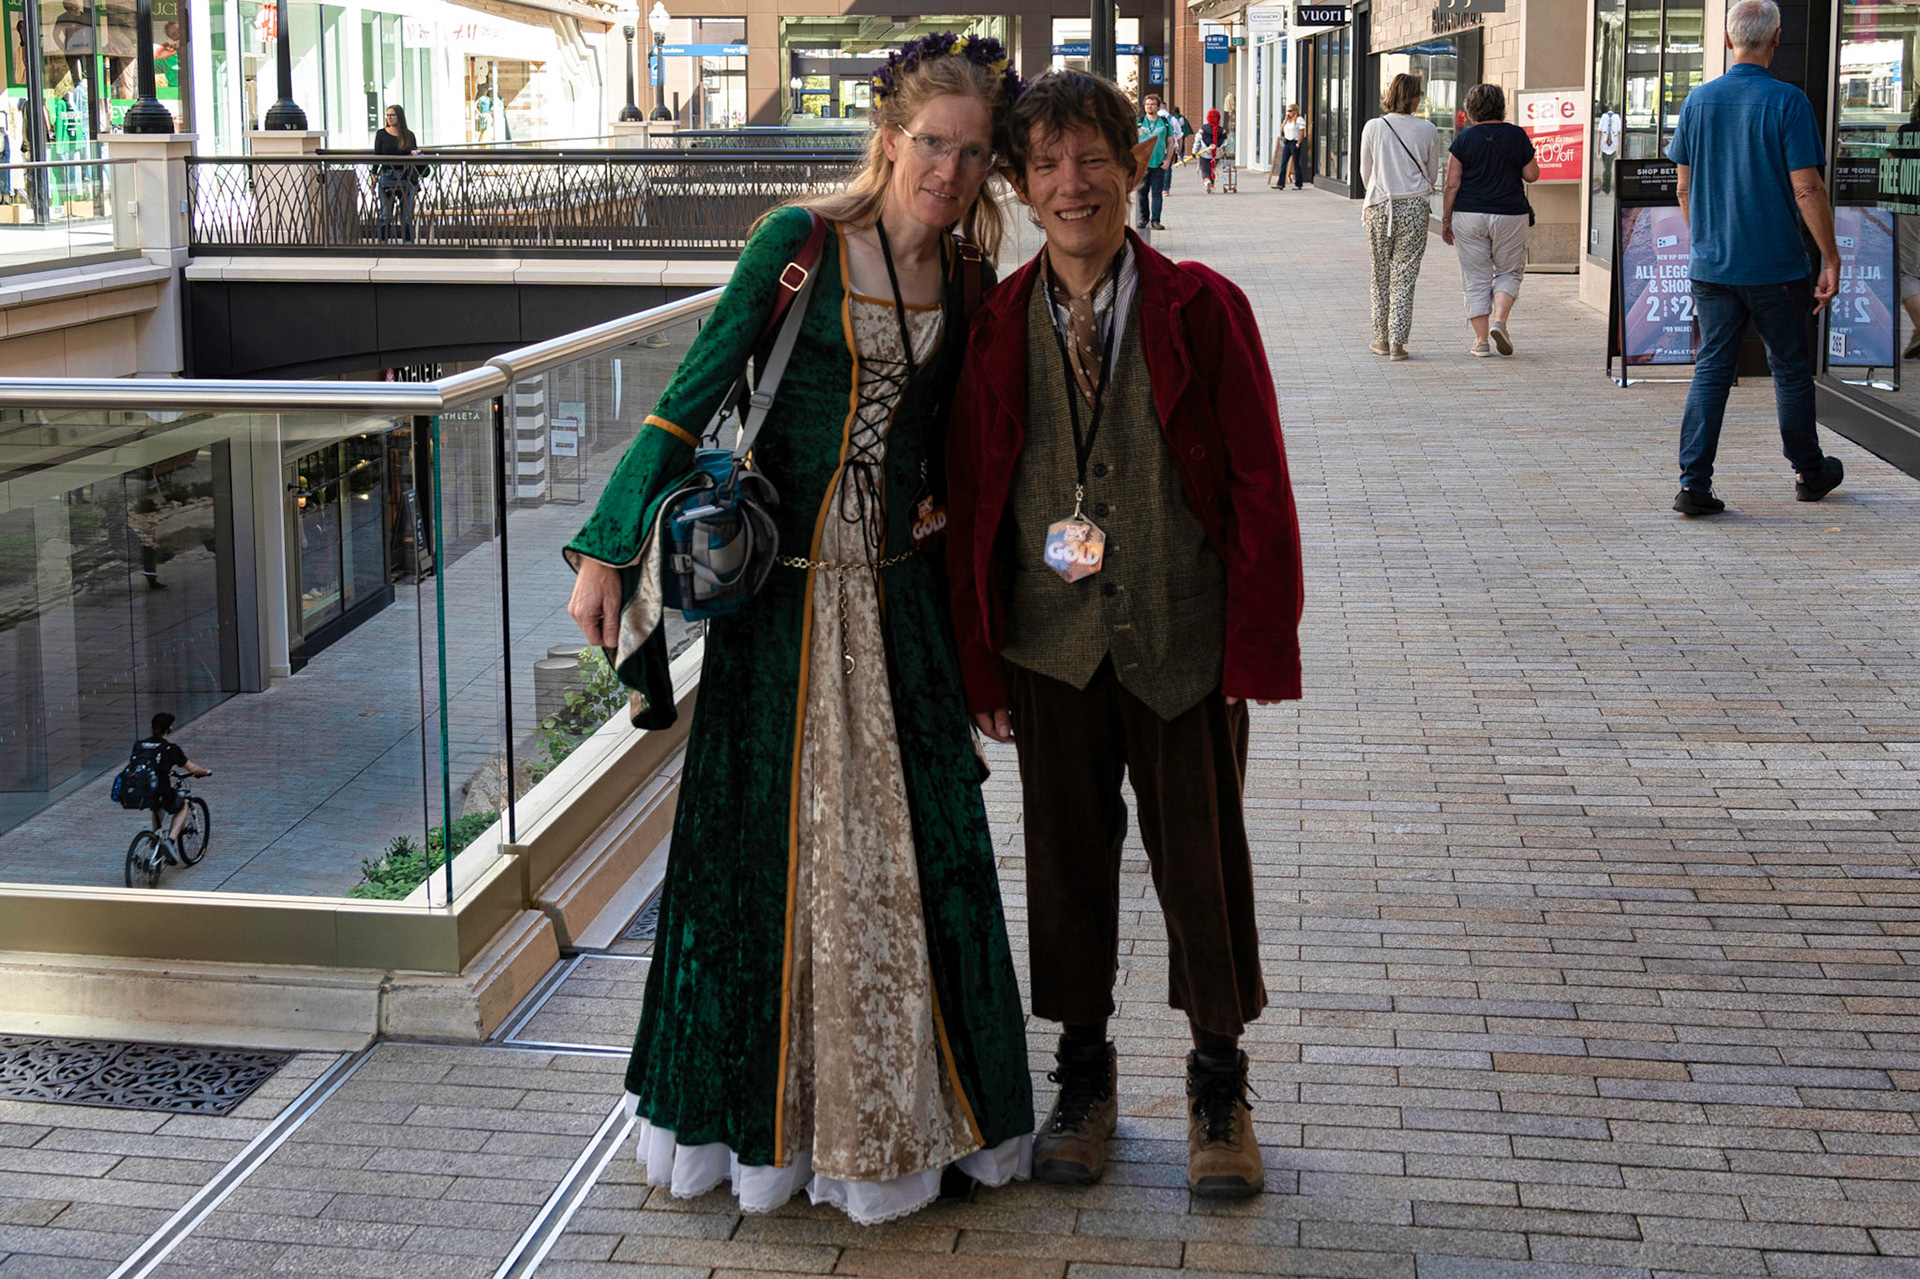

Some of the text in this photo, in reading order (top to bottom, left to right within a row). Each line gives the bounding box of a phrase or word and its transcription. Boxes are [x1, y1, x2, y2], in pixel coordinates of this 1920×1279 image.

[1301, 10, 1341, 21] vuori
[1527, 97, 1575, 119] sale
[1878, 158, 1899, 194] FREE
[1635, 265, 1688, 279] ALL LEGG
[1649, 279, 1692, 293] & SHOR
[1646, 296, 1660, 322] 2
[399, 363, 443, 382] ATHLETA
[439, 412, 480, 420] ATHLETA
[912, 511, 946, 540] GOLD
[1048, 541, 1100, 565] GOLD
